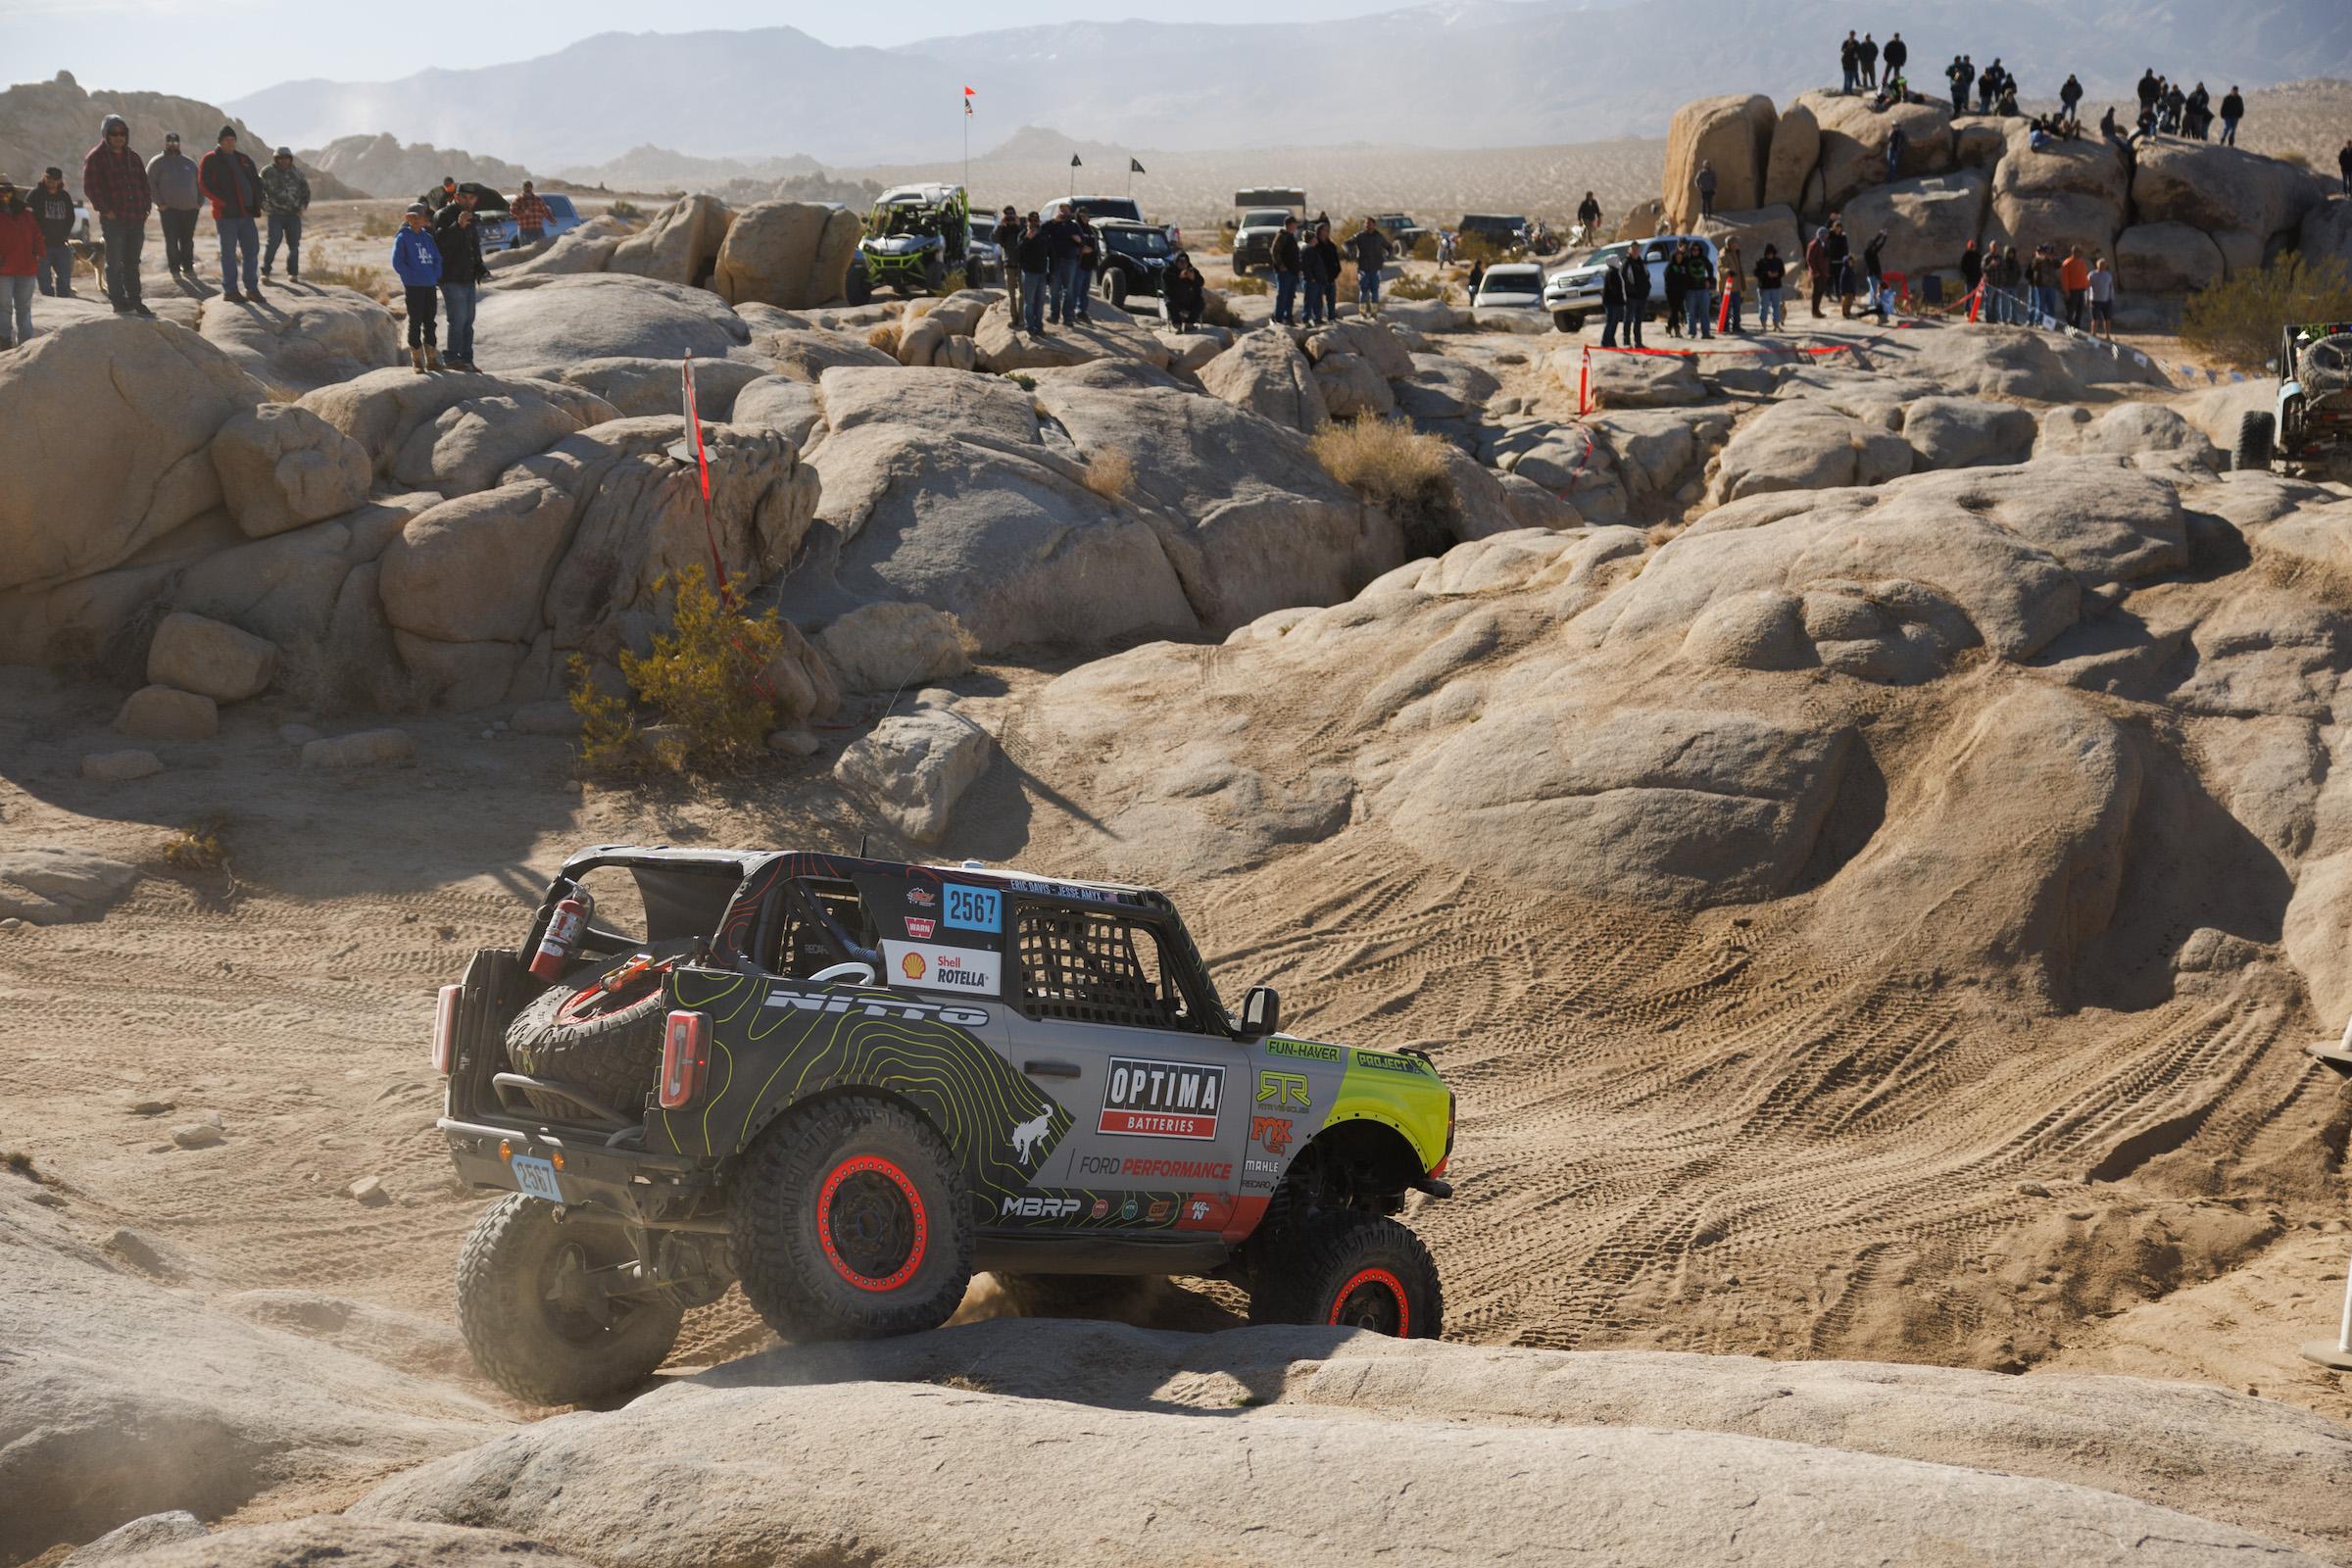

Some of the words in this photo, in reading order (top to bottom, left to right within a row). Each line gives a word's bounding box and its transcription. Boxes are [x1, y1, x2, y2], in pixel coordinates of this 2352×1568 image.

[1010, 880, 1028, 892] ERIC
[1029, 882, 1051, 894] DAVIS
[1057, 886, 1080, 899] JESSE
[1081, 890, 1102, 901] AMYX
[951, 890, 996, 923] 2567
[909, 923, 930, 933] WARN
[938, 956, 960, 967] Shell
[938, 968, 985, 987] ROTELLA
[1268, 1041, 1338, 1060] FUN-HAVER
[1358, 1054, 1408, 1071] PROJECT
[1111, 1067, 1216, 1109] OPTIMA
[1128, 1116, 1194, 1133] BATTERIES
[1251, 1116, 1294, 1152] FOX
[1080, 1155, 1120, 1175] FORD
[1121, 1158, 1233, 1180] PERFORMANCE
[1246, 1160, 1279, 1172] MAHLE
[516, 1161, 554, 1194] 2567
[1242, 1180, 1271, 1189] RECARO
[1001, 1198, 1081, 1217] MBRP
[1192, 1201, 1210, 1220] K&N
